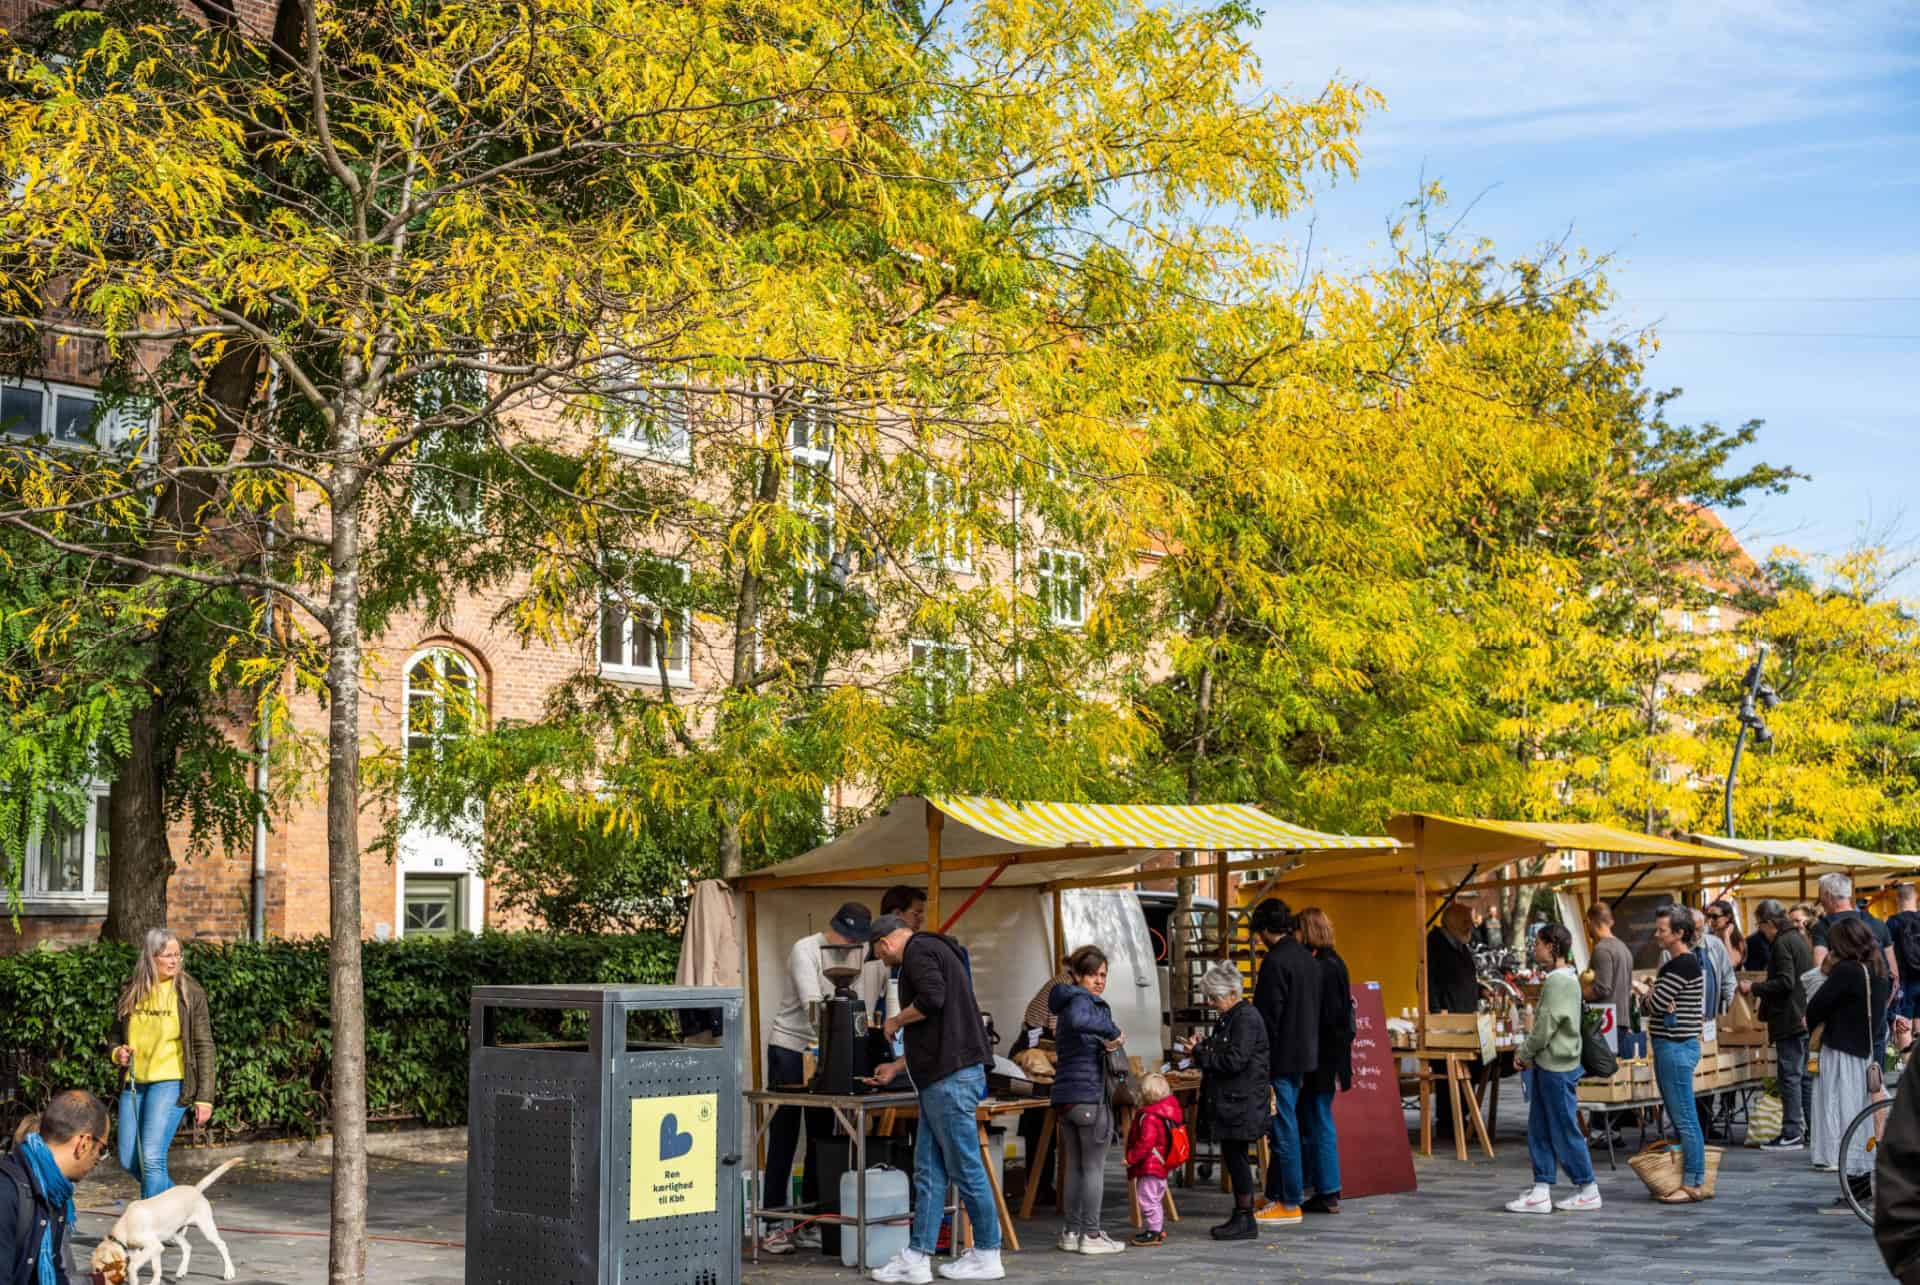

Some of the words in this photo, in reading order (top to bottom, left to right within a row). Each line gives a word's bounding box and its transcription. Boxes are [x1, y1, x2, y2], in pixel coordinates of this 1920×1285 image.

[664, 1170, 681, 1179] Ren
[653, 1181, 694, 1192] kærlighed
[658, 1195, 668, 1205] til
[669, 1194, 685, 1204] Kbh
